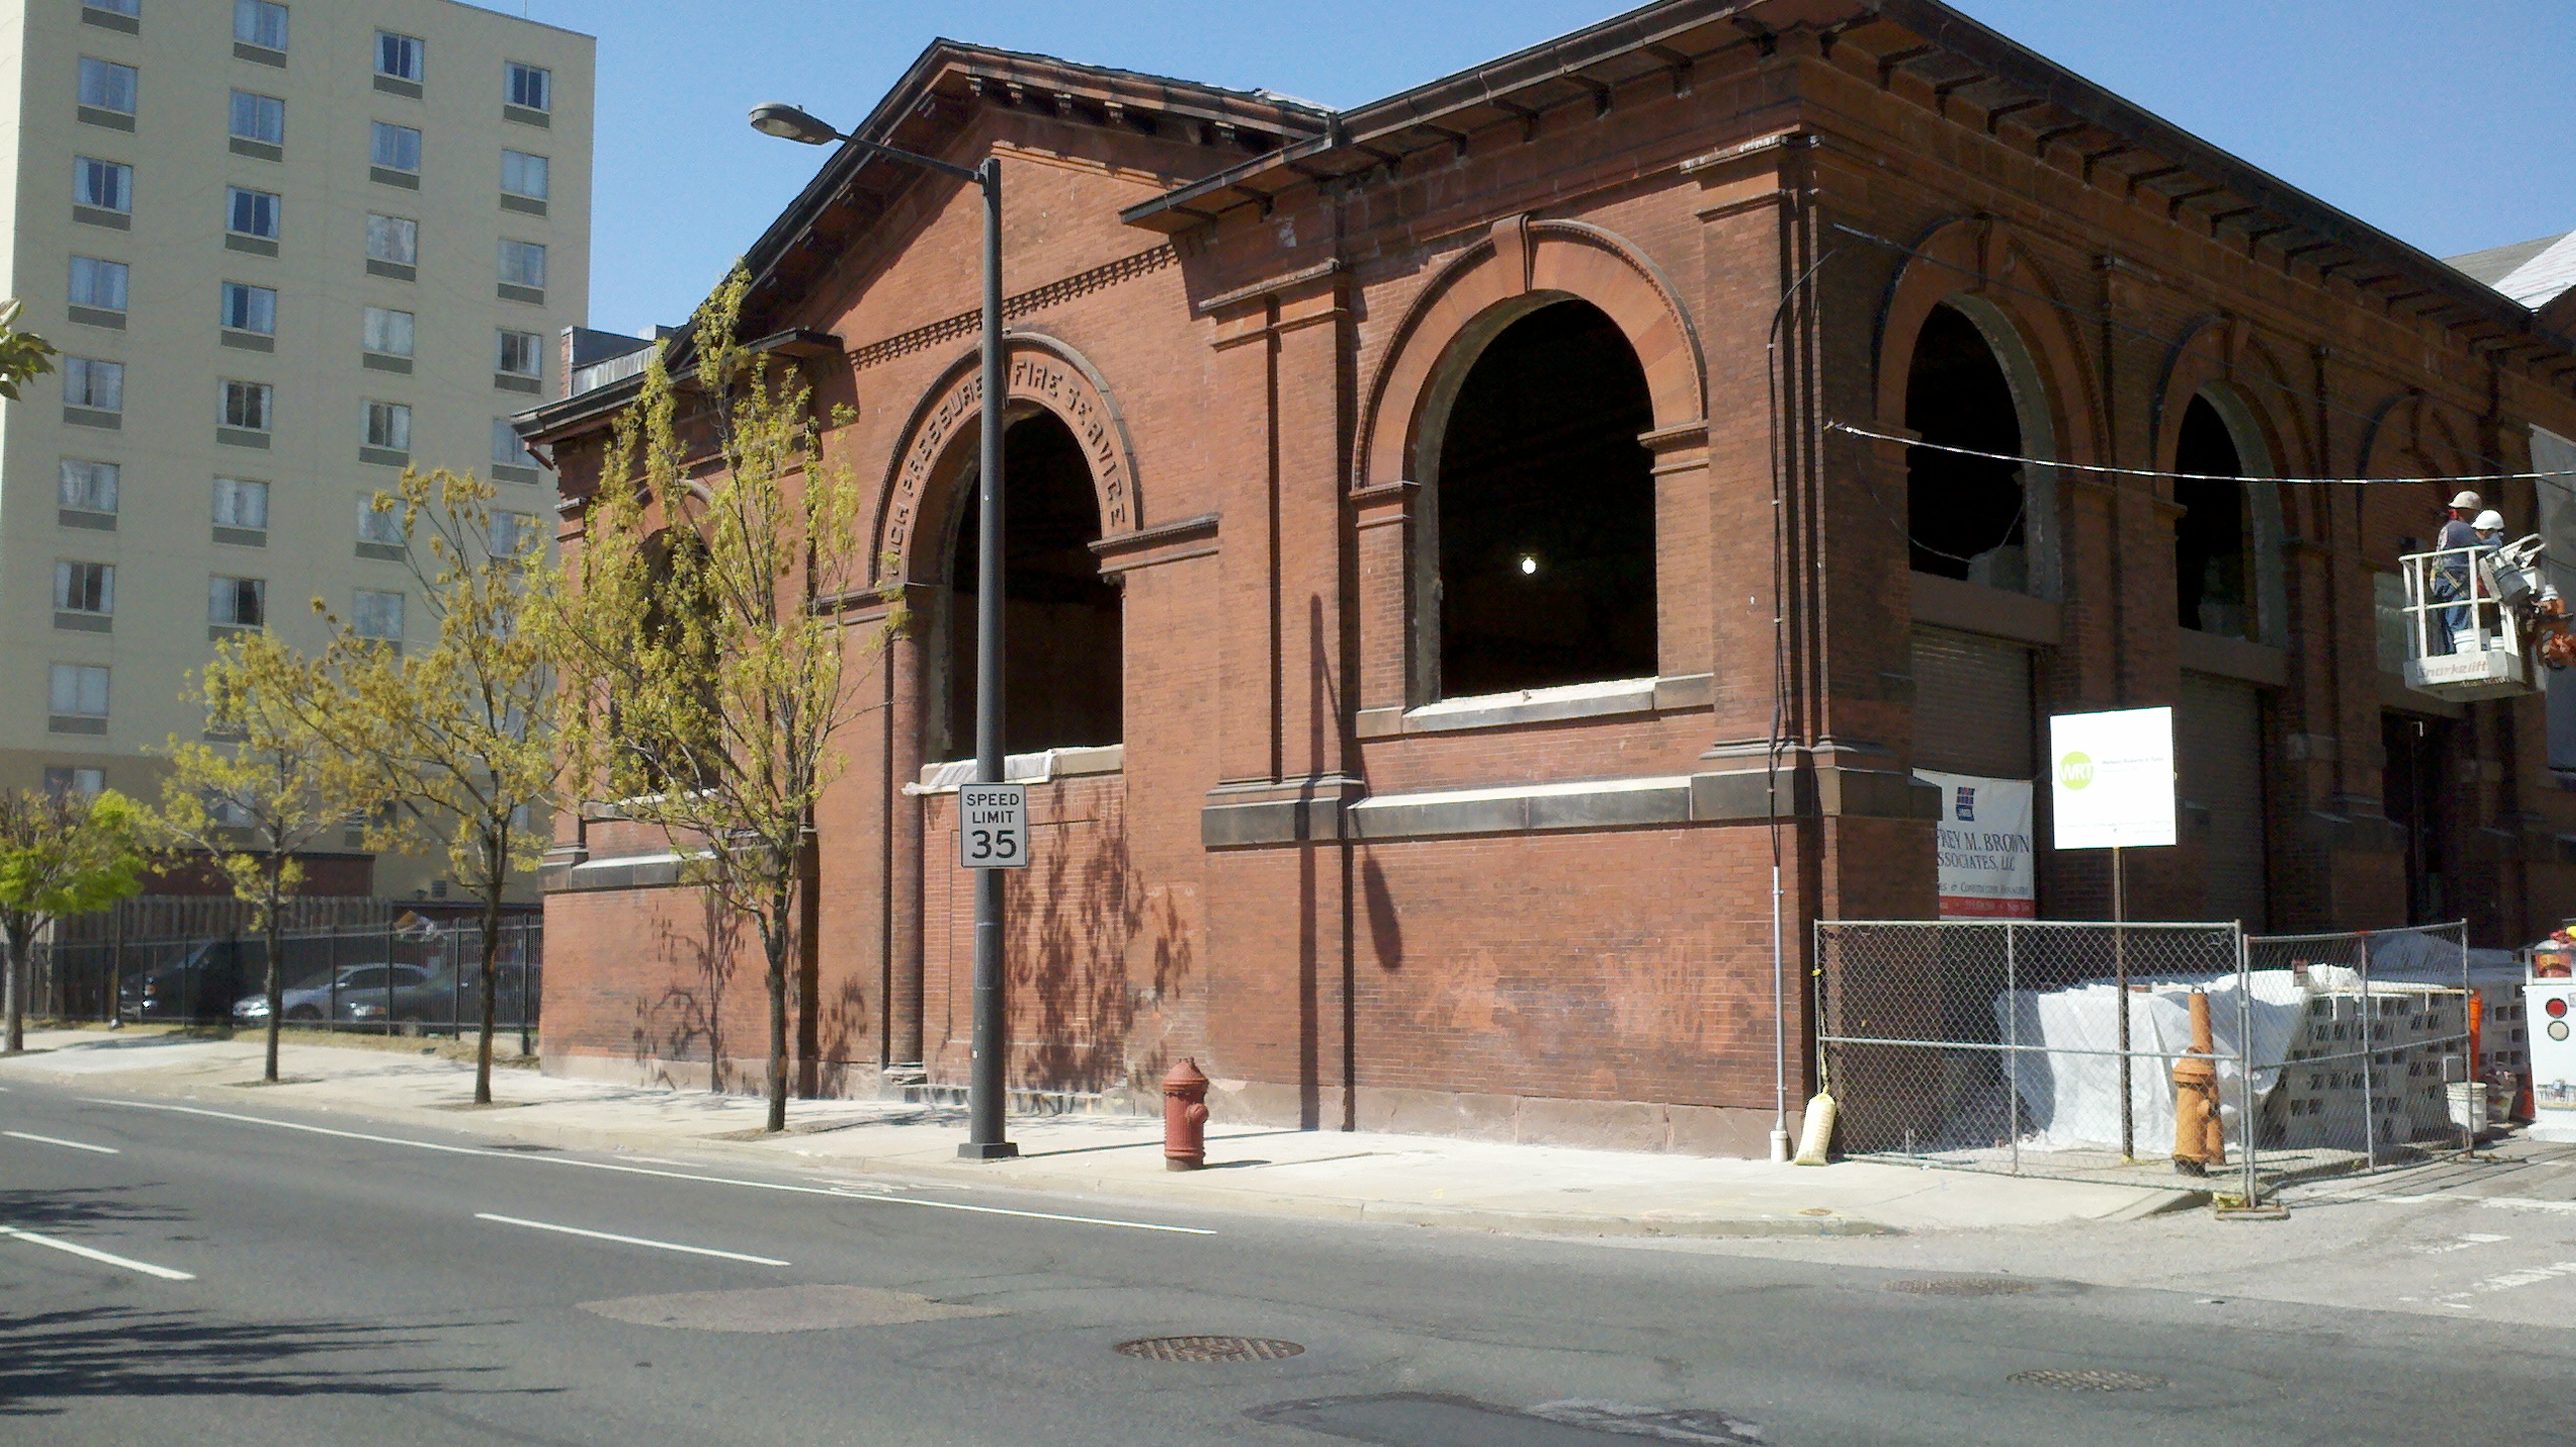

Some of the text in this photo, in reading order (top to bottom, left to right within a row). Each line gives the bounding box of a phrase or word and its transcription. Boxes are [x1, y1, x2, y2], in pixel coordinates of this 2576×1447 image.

[1014, 360, 1063, 400] FIRE
[1067, 387, 1126, 529] SERVICE
[2058, 762, 2093, 781] WRT
[966, 793, 1020, 806] SPEED
[972, 810, 1015, 824] LIMIT
[971, 829, 1017, 859] 35
[1983, 833, 2030, 854] BROWN
